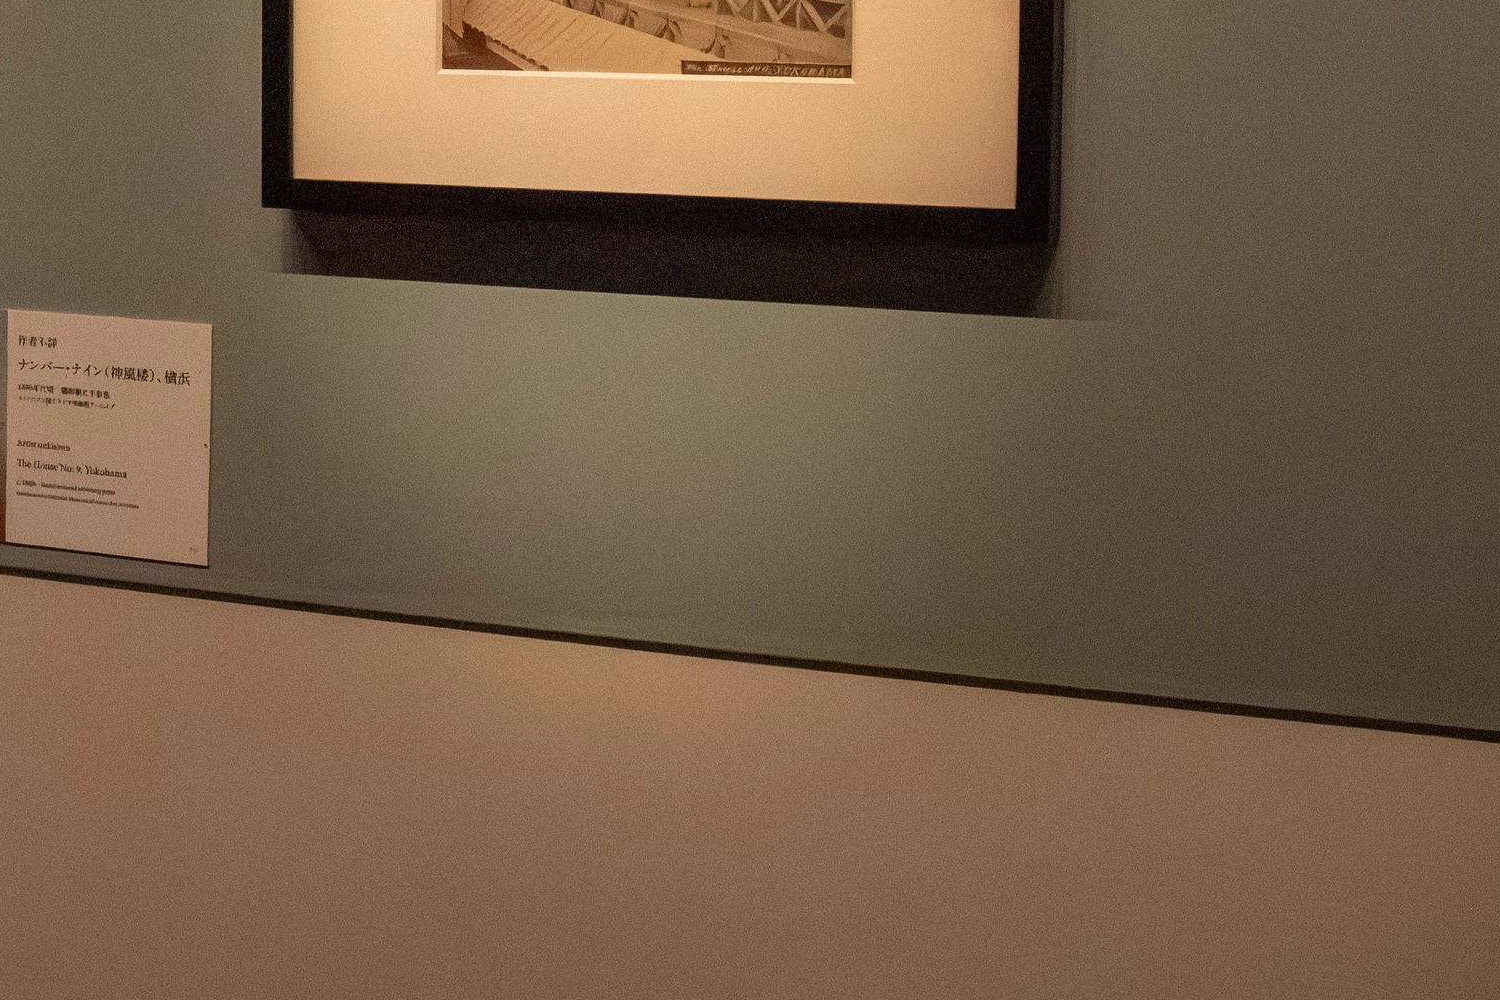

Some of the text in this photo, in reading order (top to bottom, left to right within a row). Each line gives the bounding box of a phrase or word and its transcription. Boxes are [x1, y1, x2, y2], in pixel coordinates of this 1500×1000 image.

[18, 334, 58, 349] 作者不詳
[17, 439, 71, 452] Artist unknown
[16, 458, 32, 469] The
[33, 461, 58, 471] House
[85, 465, 128, 479] Yokohama
